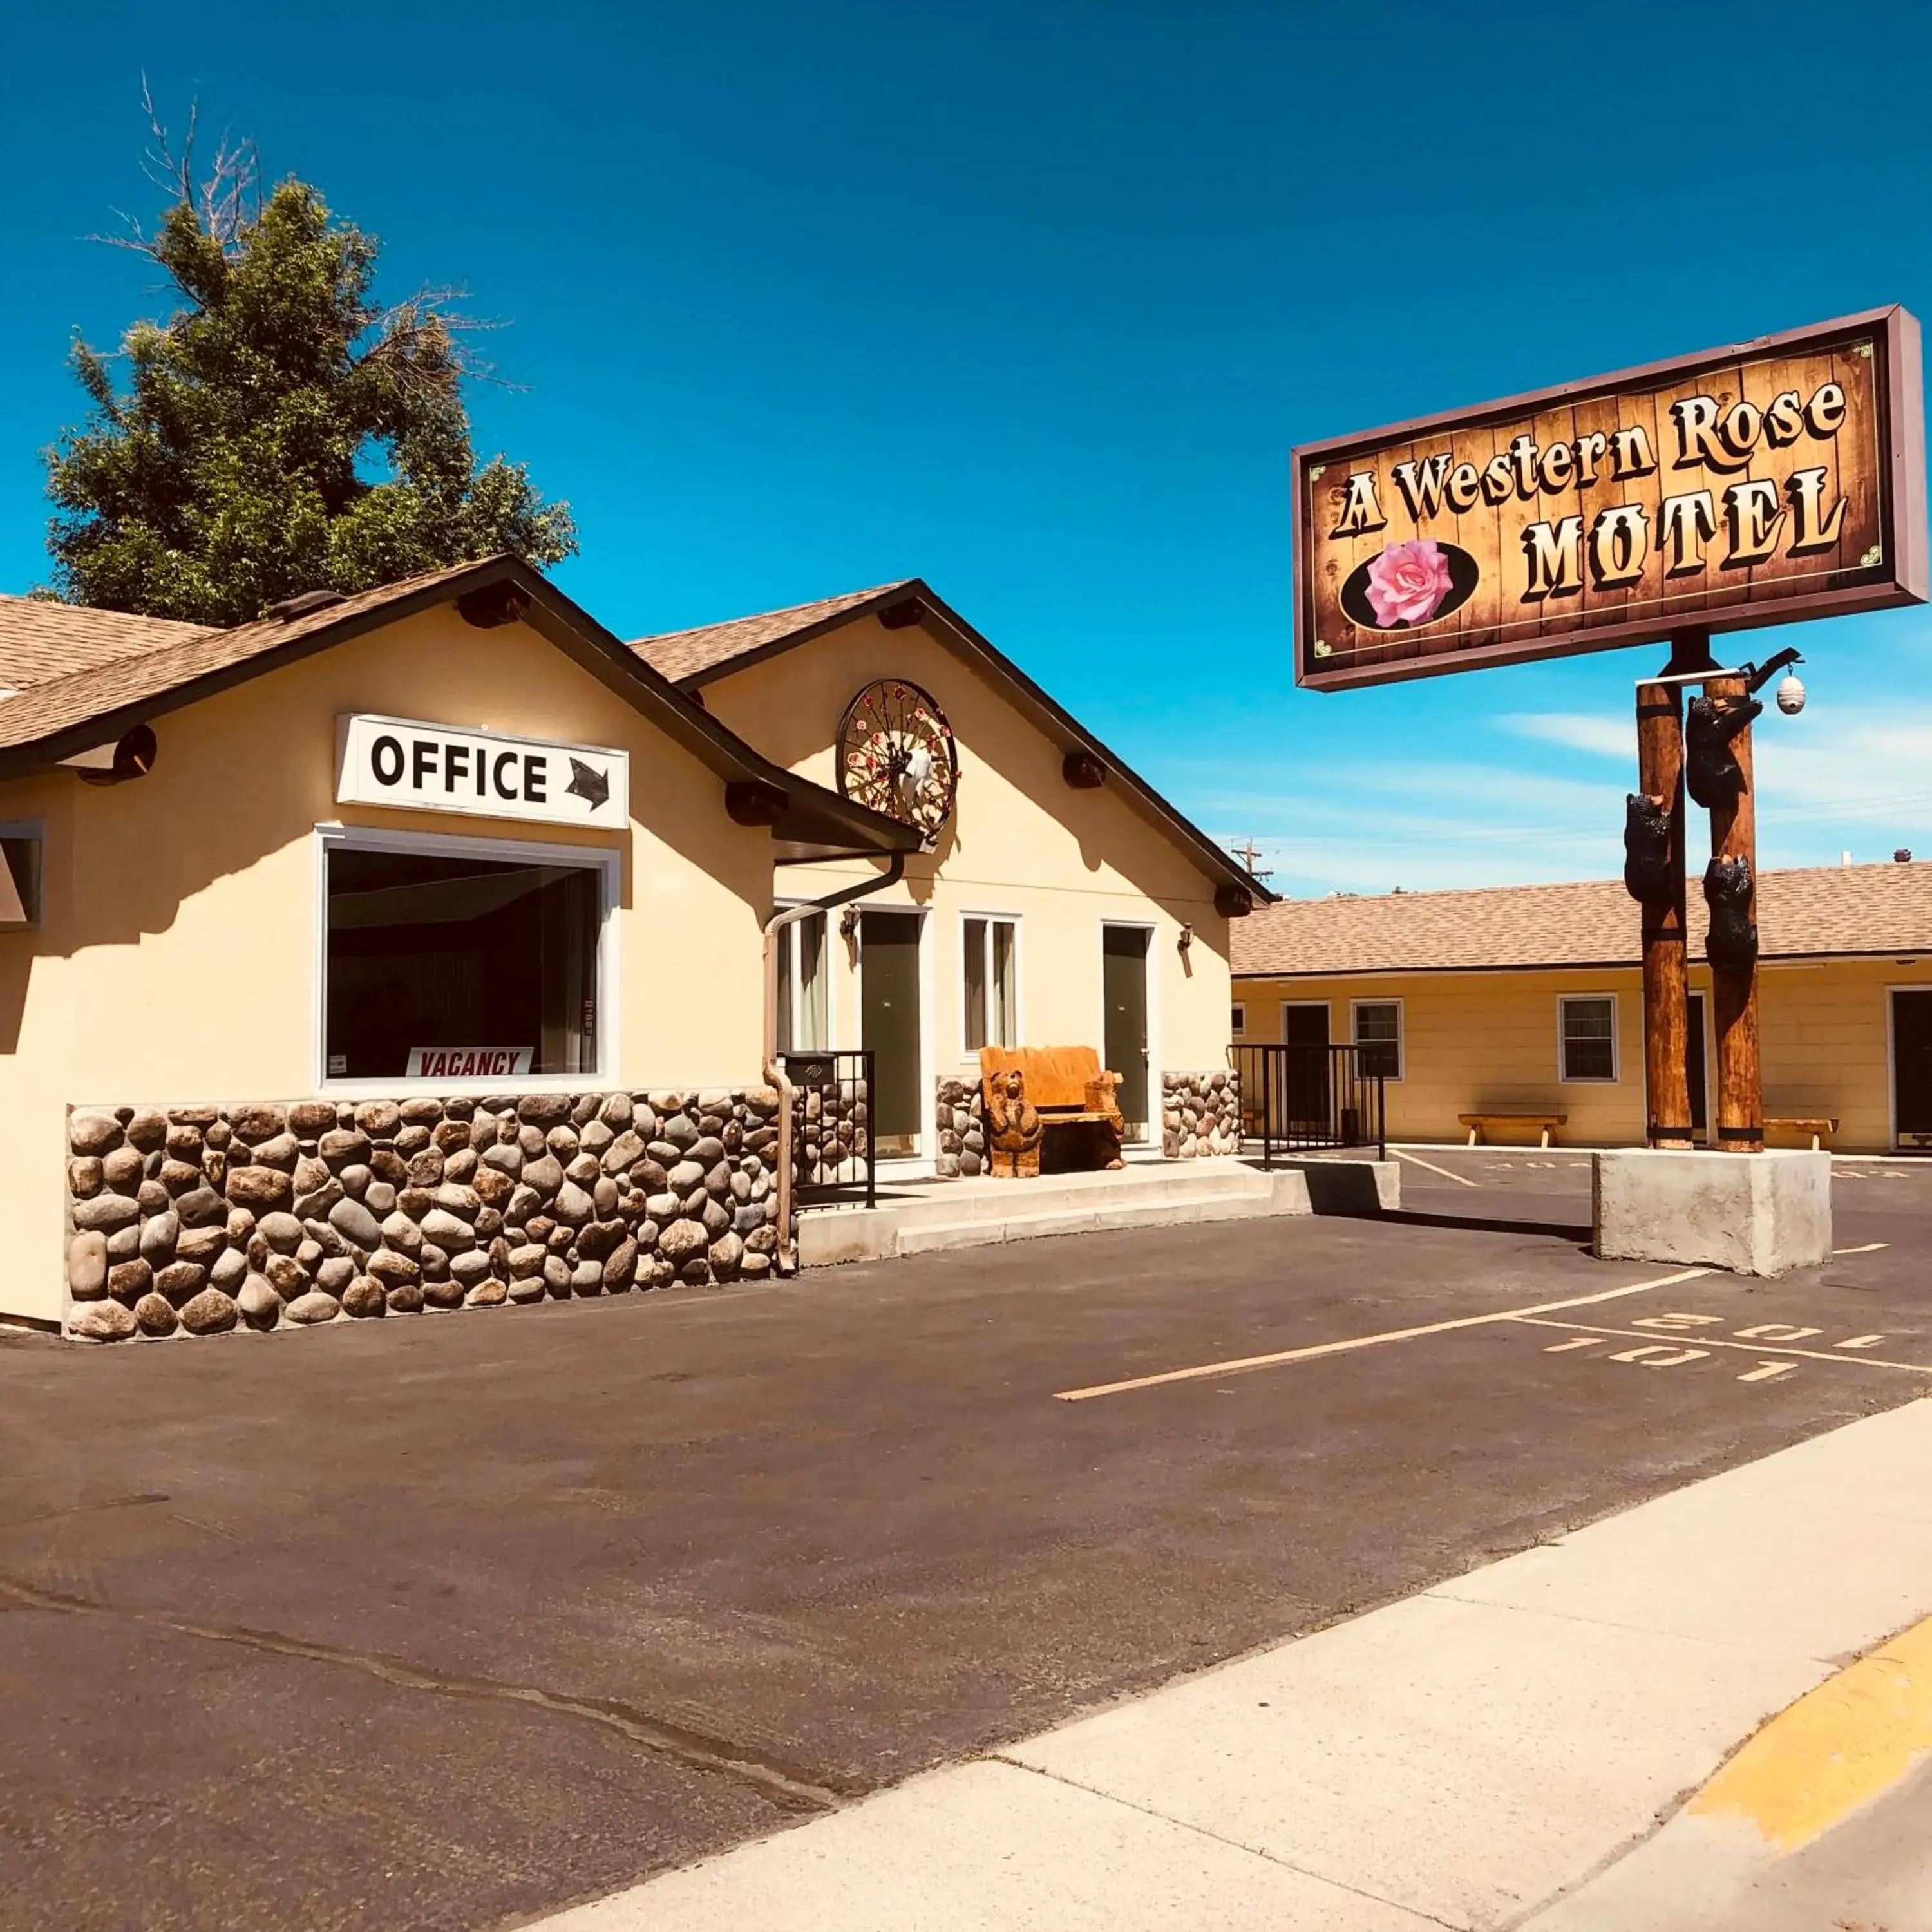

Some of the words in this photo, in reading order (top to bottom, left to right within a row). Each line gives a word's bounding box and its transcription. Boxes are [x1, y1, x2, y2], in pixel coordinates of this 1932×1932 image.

[1329, 471, 1387, 540] A
[1392, 424, 1658, 524] Western
[1669, 381, 1846, 475] Rose
[1520, 466, 1849, 604] MOTEL
[371, 735, 547, 803] OFFICE
[421, 1052, 521, 1077] VACANCY
[1542, 1337, 1799, 1382] 101
